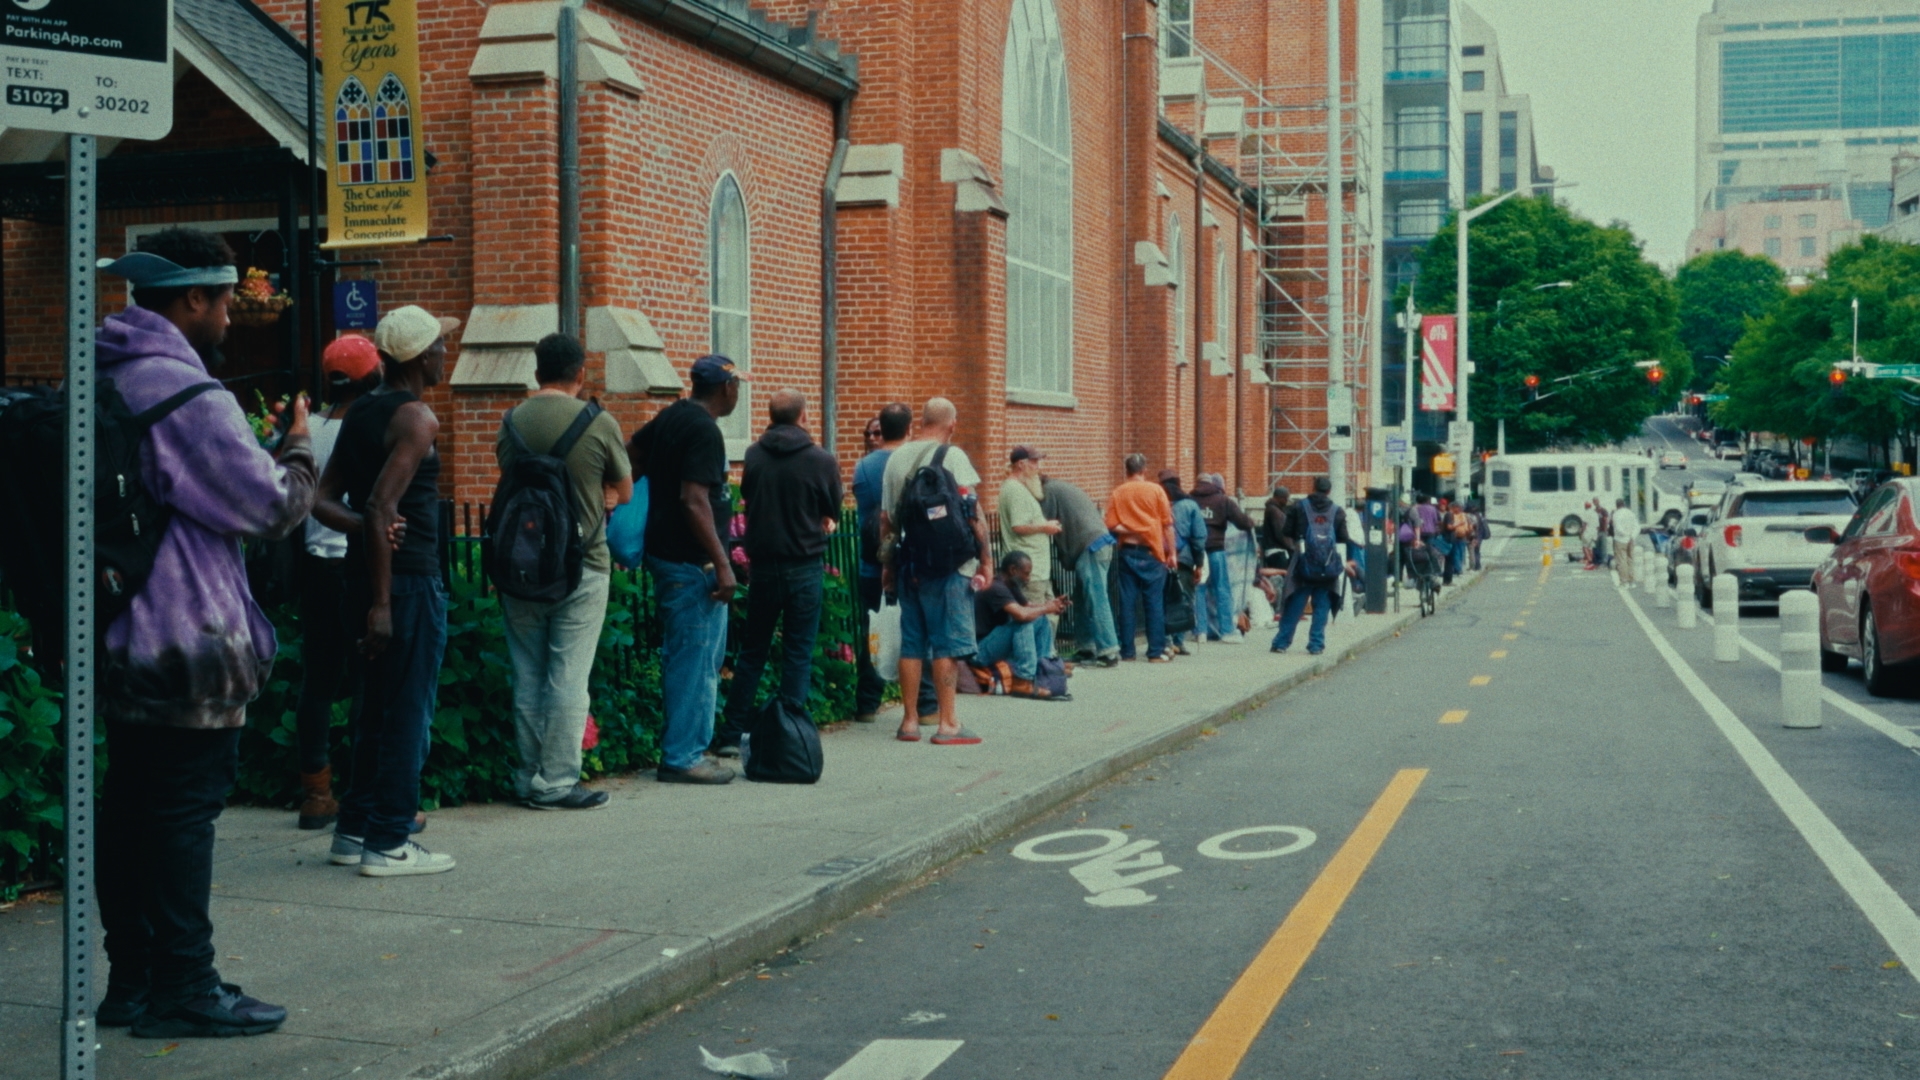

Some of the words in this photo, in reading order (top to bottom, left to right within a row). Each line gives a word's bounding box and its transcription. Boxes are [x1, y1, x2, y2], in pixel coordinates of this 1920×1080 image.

[22, 16, 40, 24] WITH
[6, 24, 123, 49] ParkingApp.com
[340, 42, 399, 72] Years
[7, 66, 43, 81] TEXT:
[95, 76, 117, 88] TO:
[12, 88, 64, 106] 51022
[95, 95, 150, 114] 30202
[343, 187, 363, 200] The
[365, 186, 411, 199] Catholic
[343, 201, 379, 213] Shrine
[344, 215, 407, 228] Immaculate
[344, 228, 406, 240] Conception
